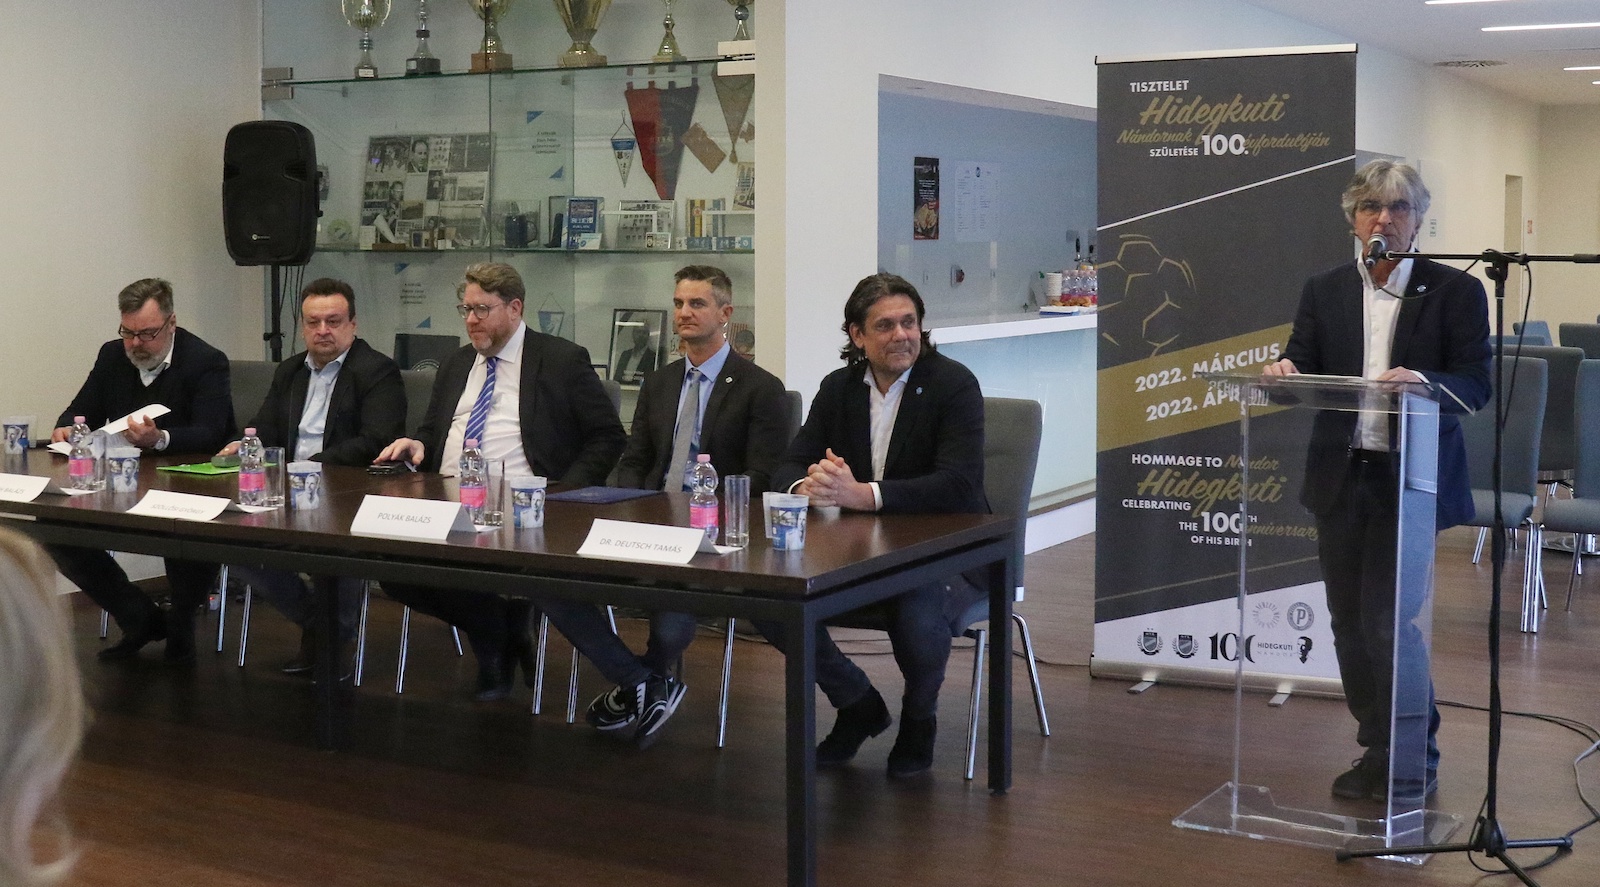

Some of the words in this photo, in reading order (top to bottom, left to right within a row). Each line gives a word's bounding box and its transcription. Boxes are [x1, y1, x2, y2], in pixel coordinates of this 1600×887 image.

[1130, 80, 1190, 93] TISZTELET
[1140, 93, 1290, 145] Hidegkuti
[1116, 128, 1193, 145] Nándornak
[1149, 144, 1199, 157] SZÜLETÉSE
[1201, 133, 1249, 156] 100.
[1135, 367, 1187, 393] 2022.
[1191, 342, 1281, 379] MÁRCIUS
[1146, 396, 1198, 422] 2022.
[1131, 453, 1203, 468] HOMMAGE
[1204, 456, 1223, 469] TO
[1121, 498, 1192, 512] CELEBRATING
[405, 514, 432, 524] BALÁZS
[1178, 521, 1198, 532] THE
[614, 540, 653, 550] DEUTSCH
[653, 543, 682, 554] TAMÁS
[1191, 535, 1205, 545] OF
[1206, 537, 1223, 546] HIS
[1224, 537, 1253, 547] BIRH
[1257, 642, 1293, 651] HIDEGKUTI
